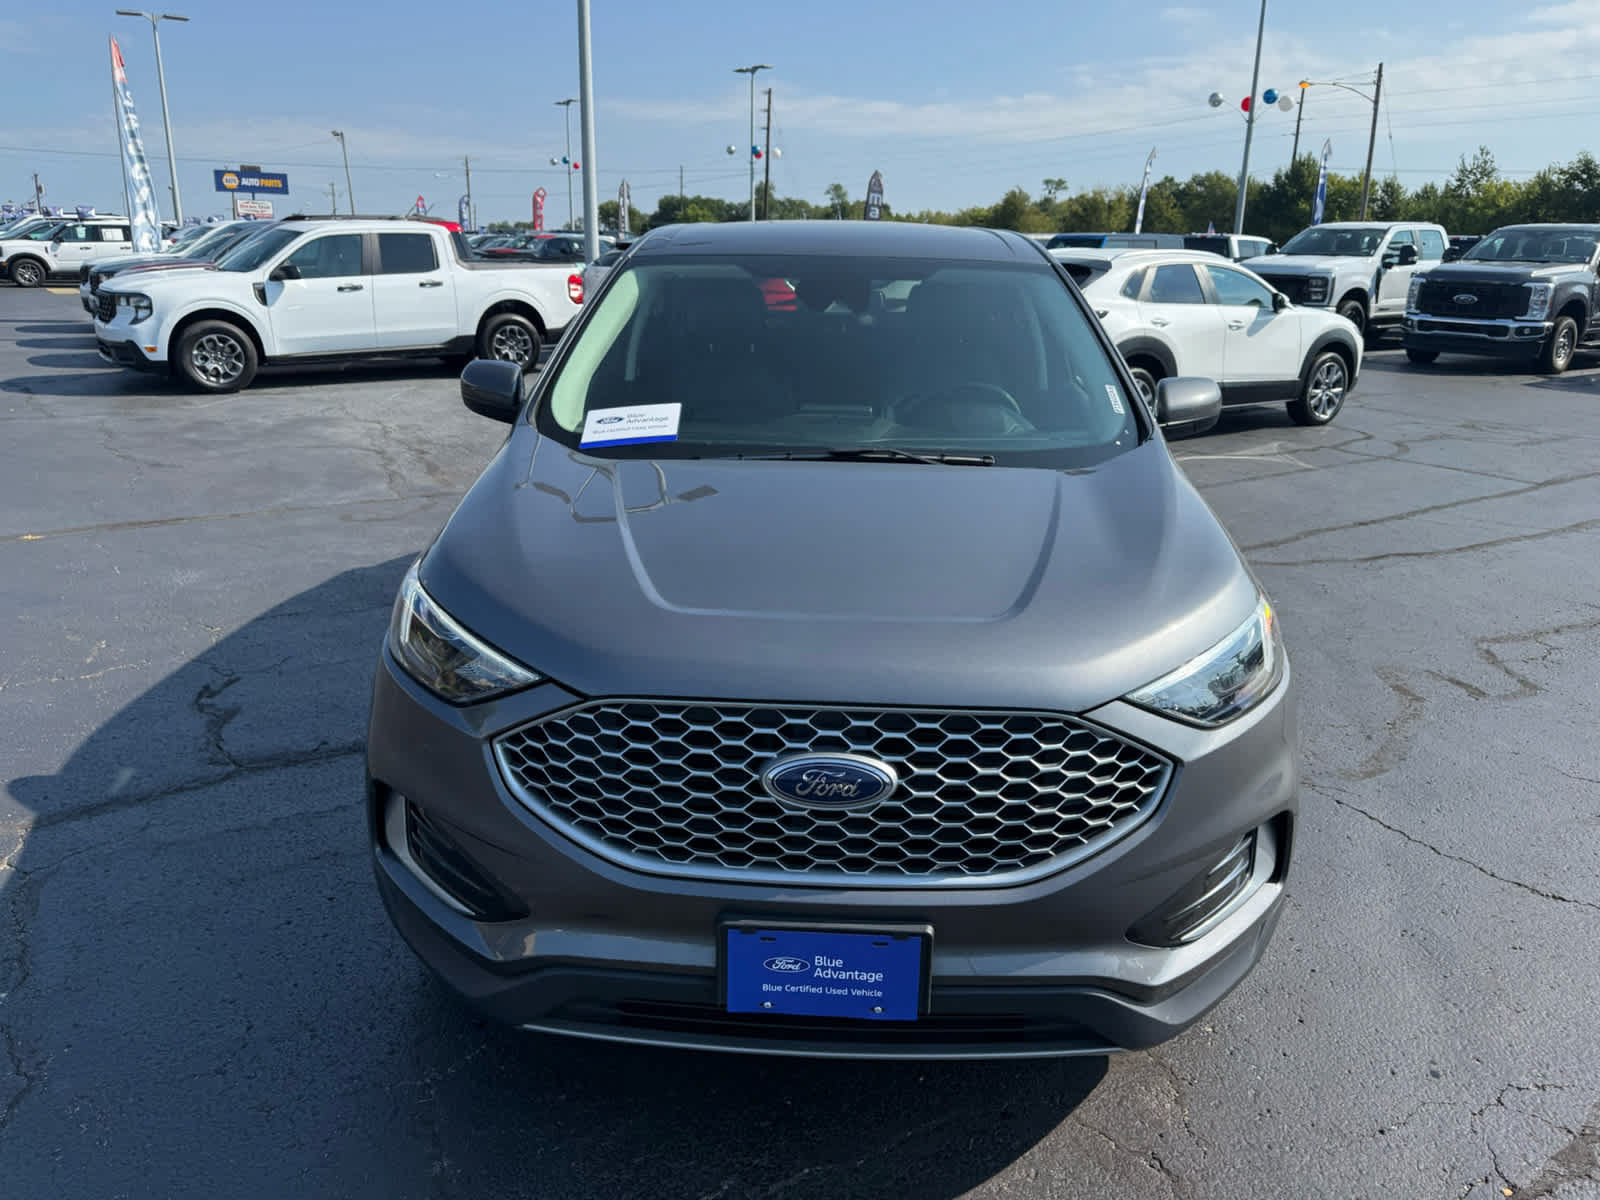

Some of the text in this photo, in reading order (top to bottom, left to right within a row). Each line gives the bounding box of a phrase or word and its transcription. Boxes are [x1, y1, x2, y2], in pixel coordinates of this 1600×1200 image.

[241, 177, 283, 188] AUTO PARTS
[795, 769, 862, 797] Ford
[772, 958, 801, 971] Ford
[814, 955, 843, 968] Blue
[813, 967, 884, 983] Advantage
[762, 983, 883, 997] Blue Certified Used Vehicle
